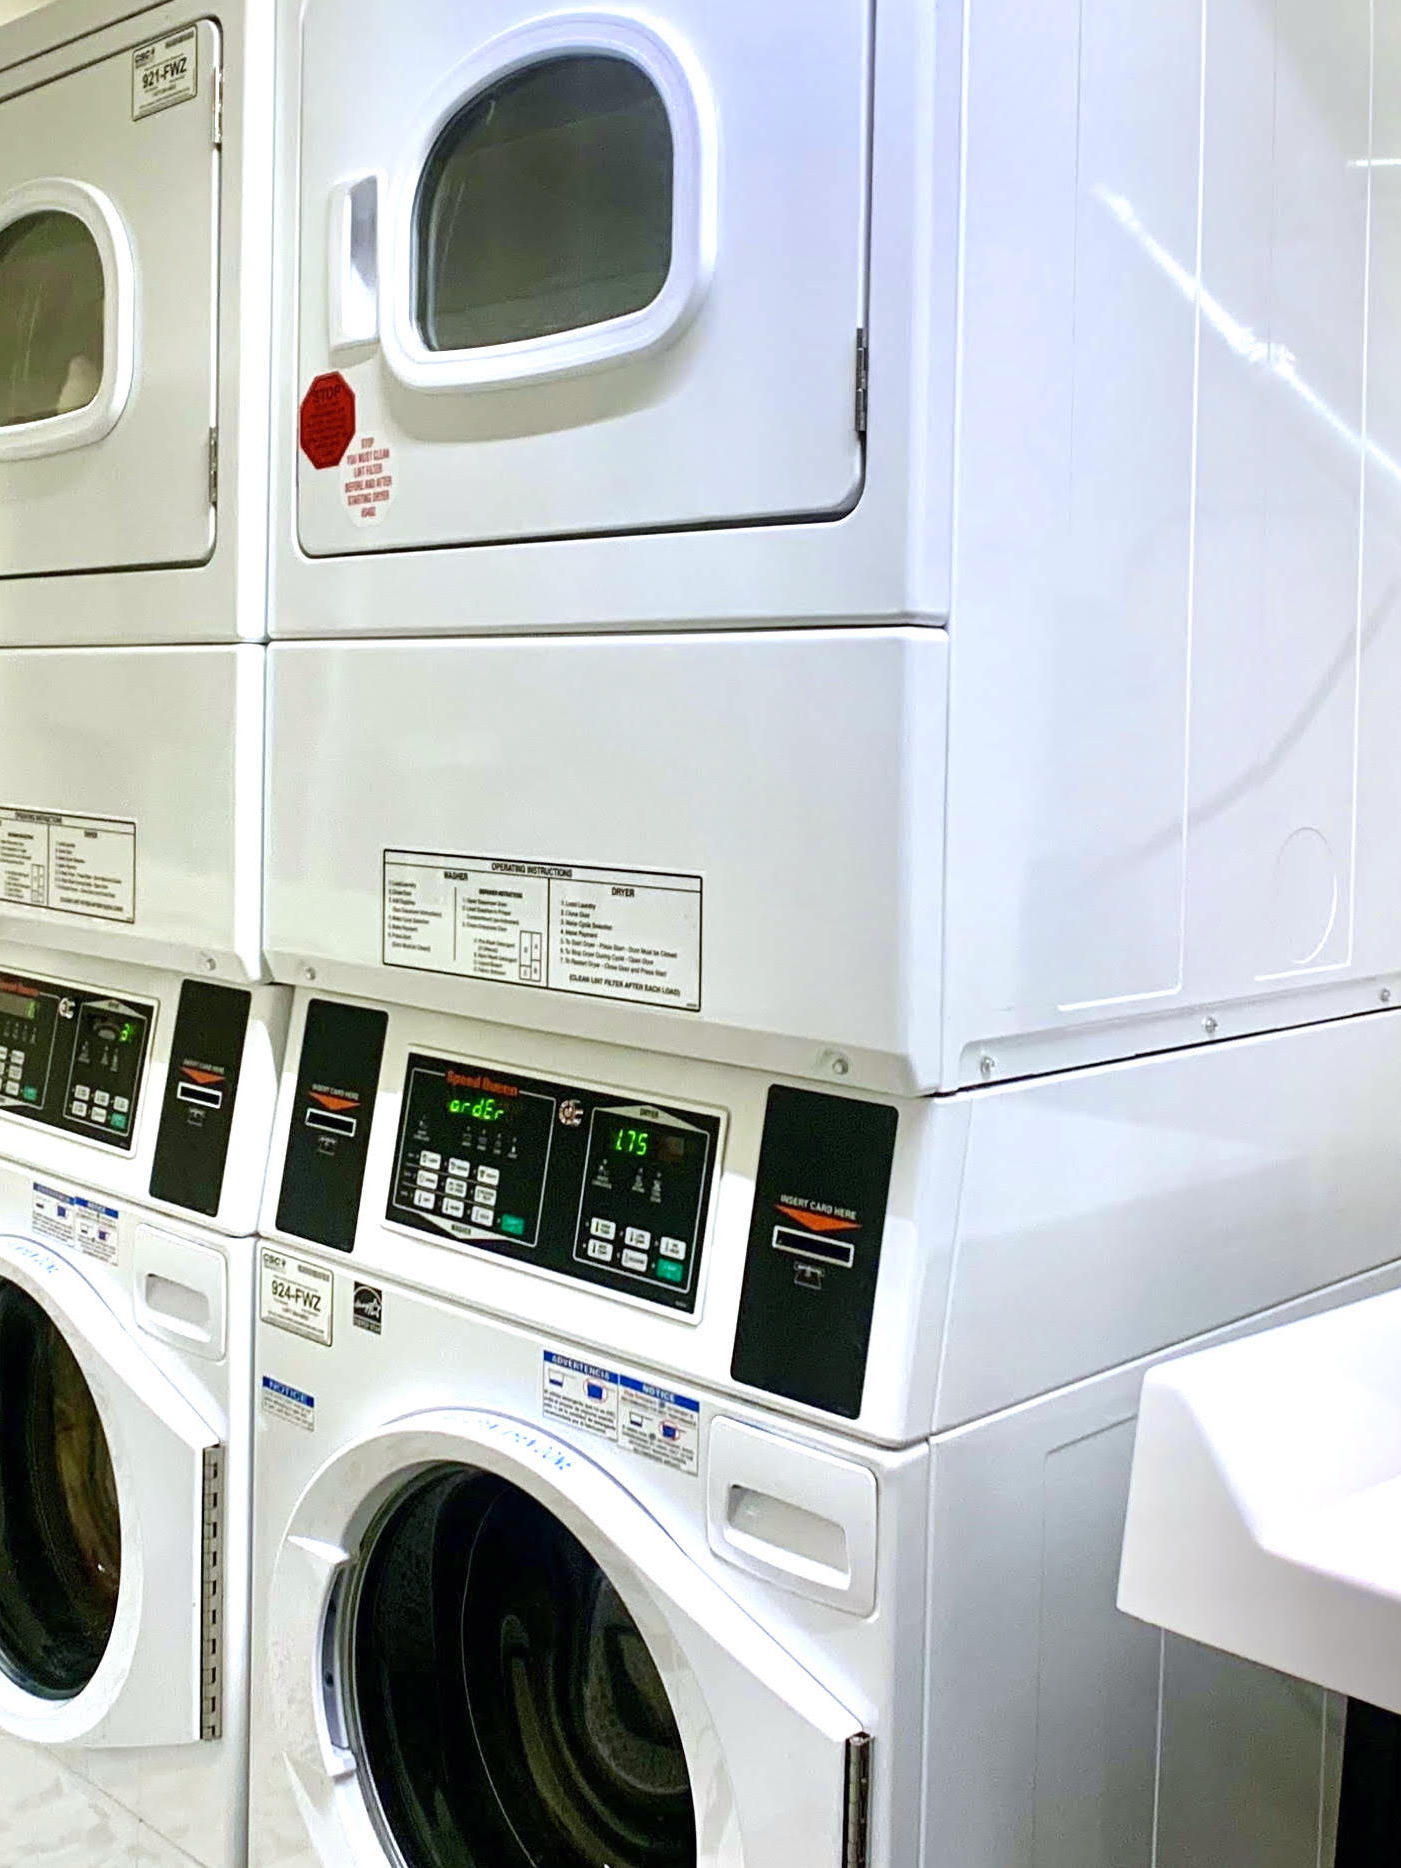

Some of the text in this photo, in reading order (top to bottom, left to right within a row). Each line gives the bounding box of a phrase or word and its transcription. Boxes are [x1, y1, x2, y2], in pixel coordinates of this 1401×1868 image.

[142, 57, 187, 89] 921-FWZ
[444, 871, 468, 881] WASHER
[491, 862, 573, 878] OPERATING INSTRUCTIONS
[611, 886, 635, 897] DRYER
[604, 978, 623, 988] FILTER
[624, 980, 643, 990] AFTER
[780, 1194, 857, 1220] INSERT CARD HERE
[271, 1280, 322, 1313] 924-FWZ
[551, 1354, 610, 1381] ADVERTENCIA
[268, 1379, 307, 1405] NOTICE
[642, 1383, 675, 1403] NOTICE
